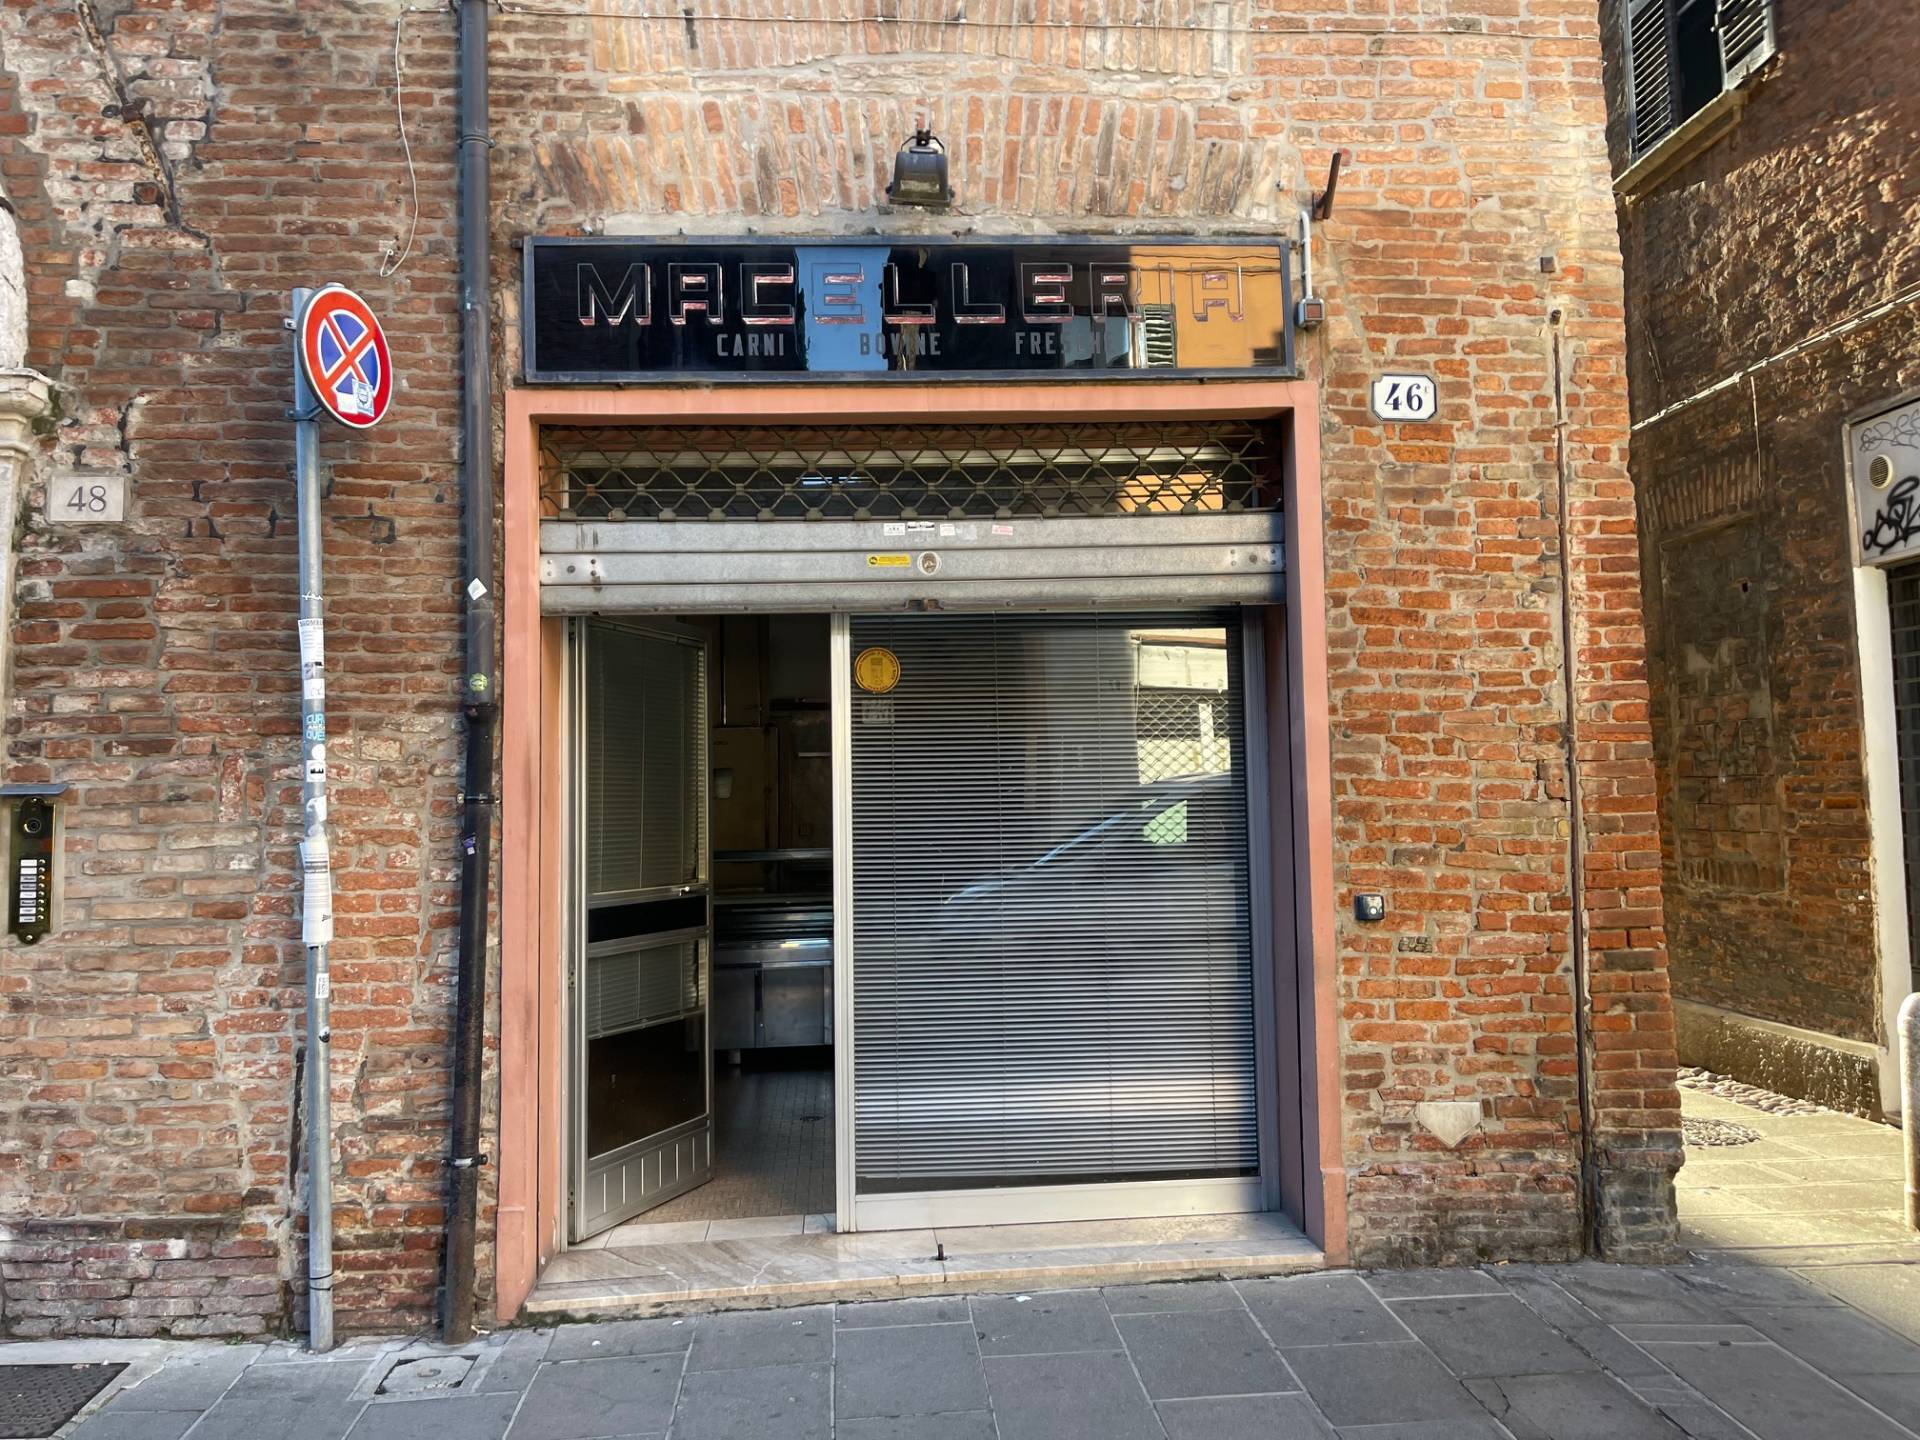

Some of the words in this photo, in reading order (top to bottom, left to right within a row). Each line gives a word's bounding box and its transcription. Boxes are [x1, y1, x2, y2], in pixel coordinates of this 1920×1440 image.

[576, 262, 1244, 325] MACELLERIA
[716, 333, 784, 357] CARNI
[859, 332, 941, 356] BOVINE
[66, 485, 106, 512] 48
